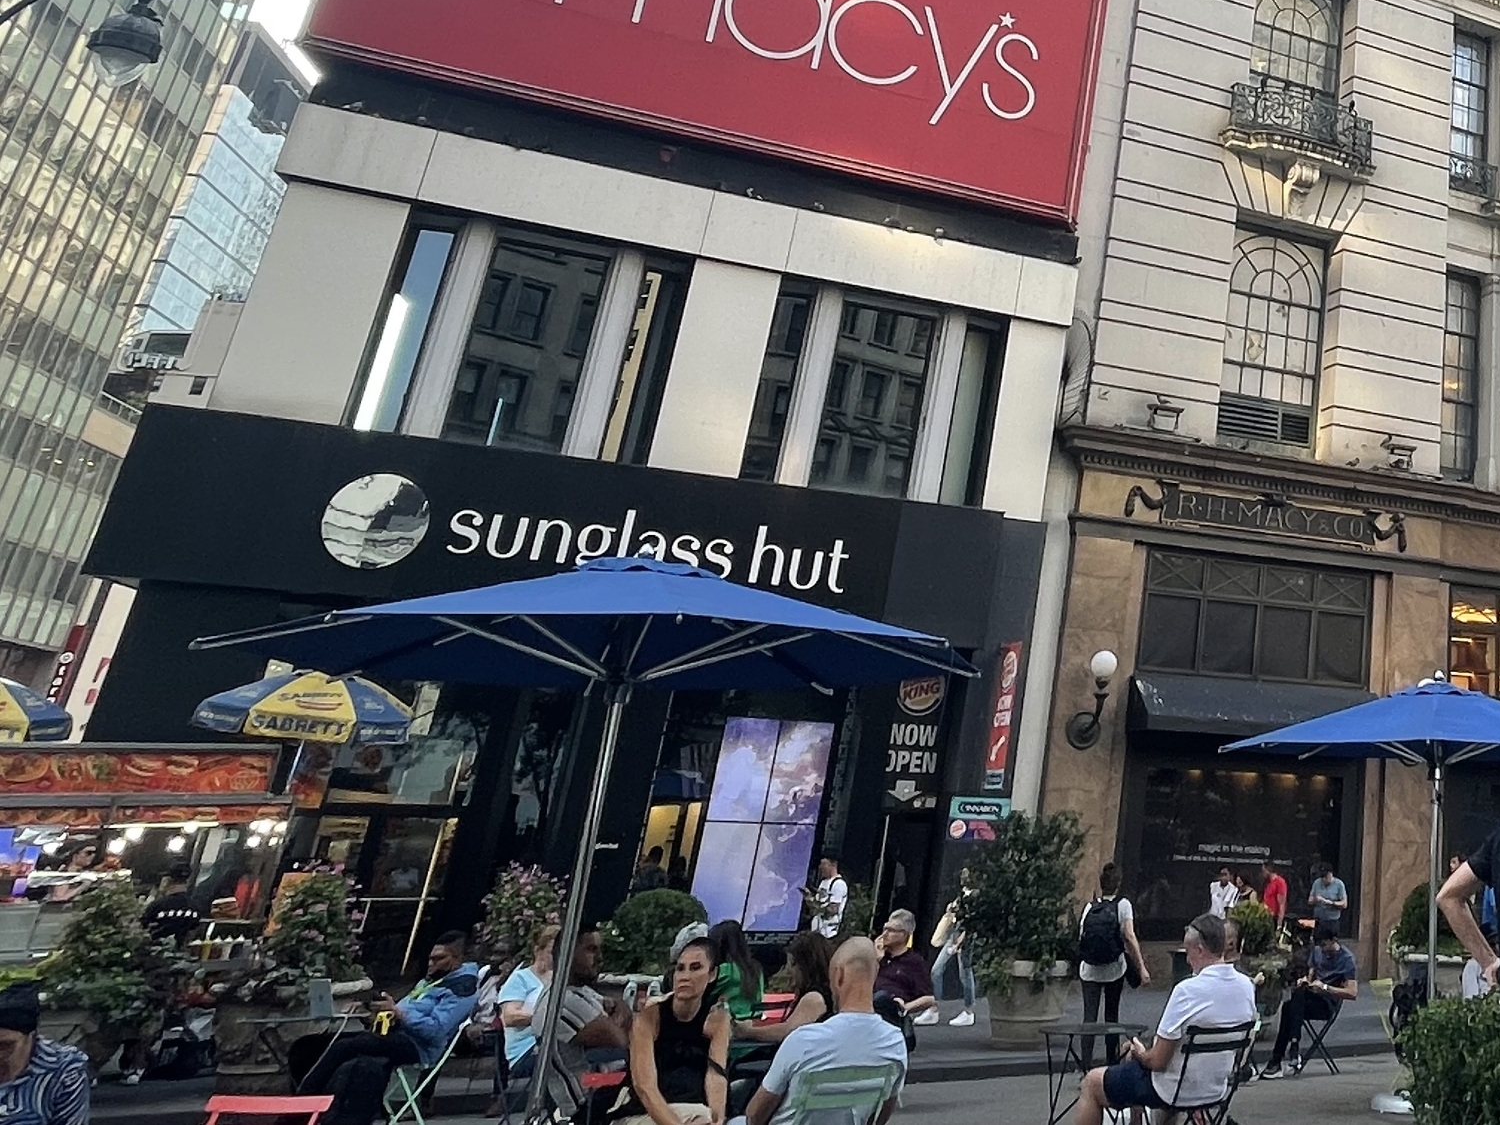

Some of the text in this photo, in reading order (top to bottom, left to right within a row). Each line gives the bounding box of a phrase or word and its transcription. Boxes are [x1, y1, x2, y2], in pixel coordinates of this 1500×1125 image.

[445, 508, 850, 594] sunglass hut
[903, 681, 940, 702] KING
[250, 712, 346, 737] SABRETT
[889, 722, 938, 747] NOW
